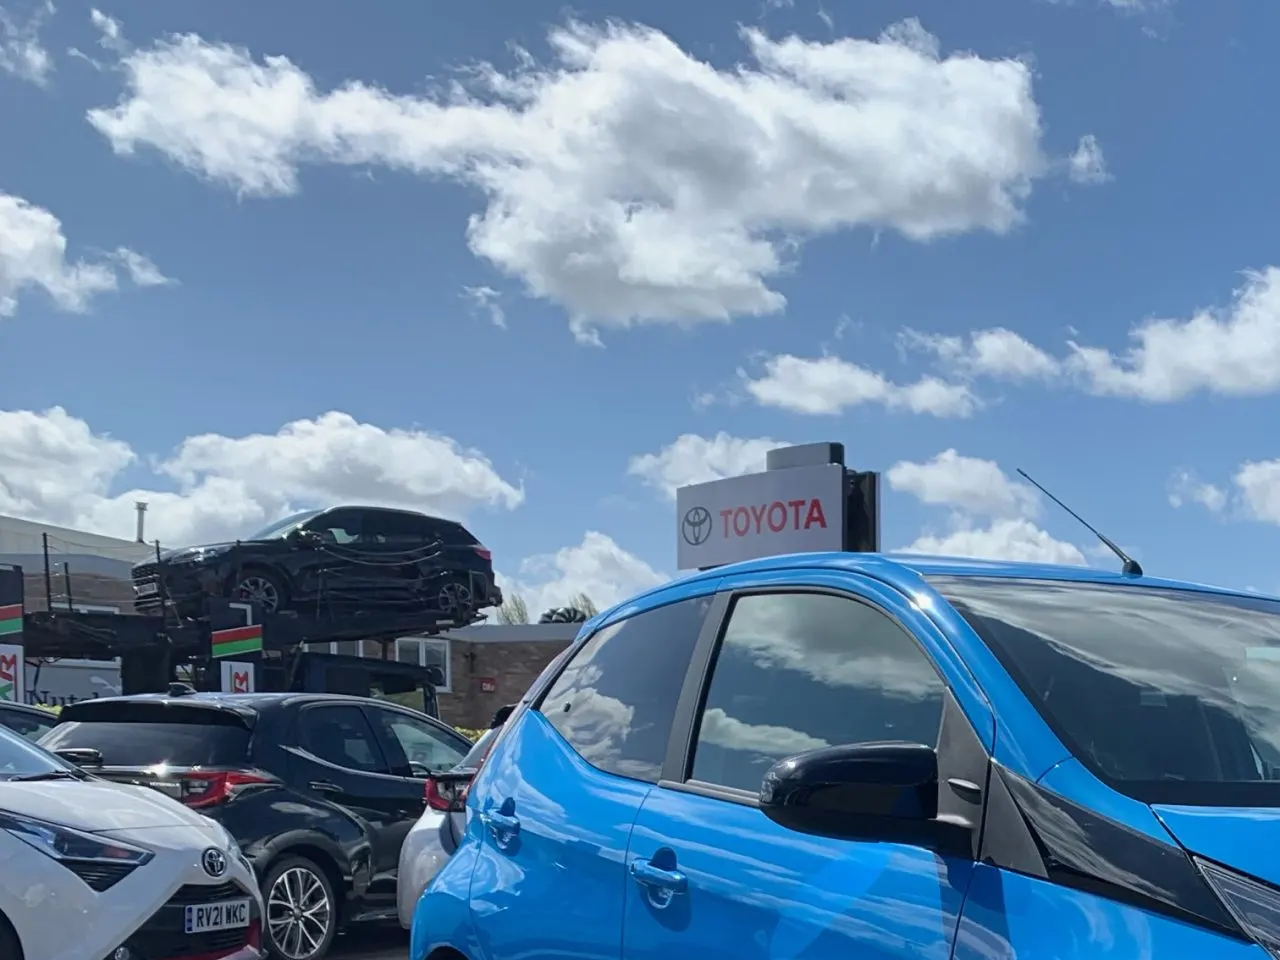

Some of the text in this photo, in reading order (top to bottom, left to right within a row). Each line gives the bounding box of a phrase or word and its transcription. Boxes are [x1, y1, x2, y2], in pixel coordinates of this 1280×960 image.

[720, 497, 828, 538] TOYOTA
[196, 903, 246, 927] RV21 WKC
